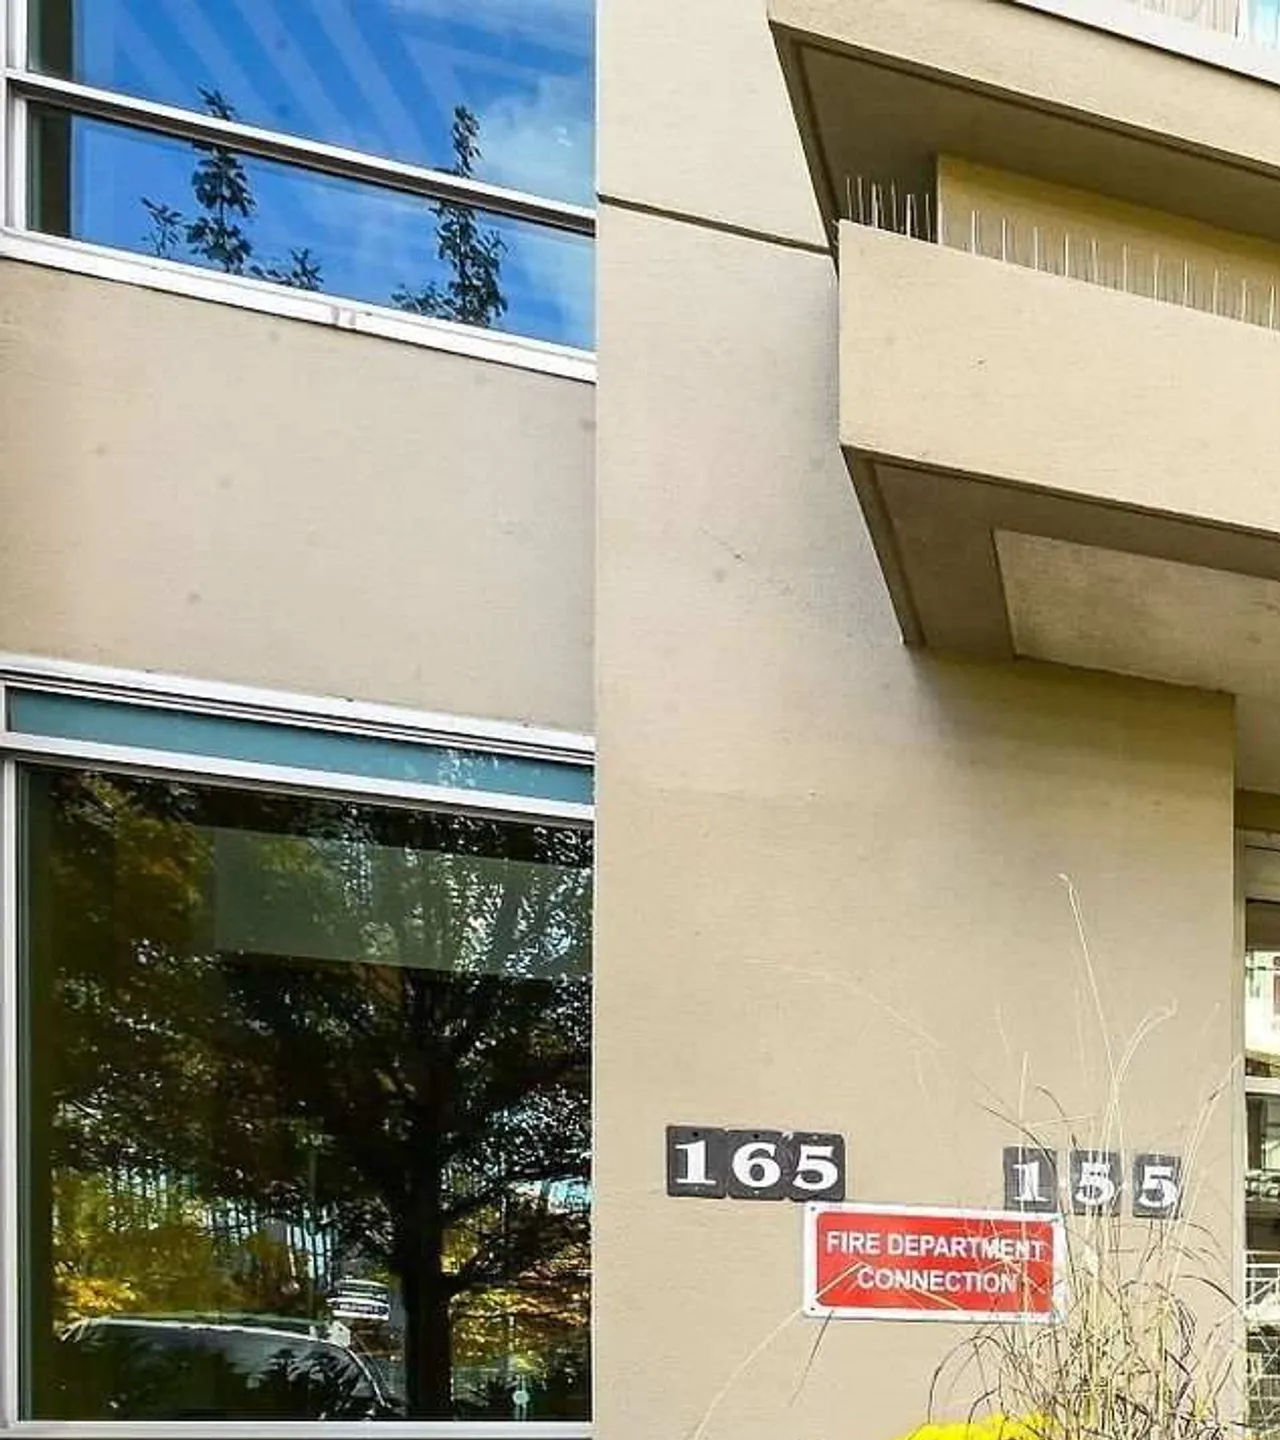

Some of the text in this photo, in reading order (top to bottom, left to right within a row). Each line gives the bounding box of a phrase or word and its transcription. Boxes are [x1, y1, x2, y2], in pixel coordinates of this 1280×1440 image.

[675, 1139, 840, 1191] 165
[1011, 1159, 1179, 1208] 155
[826, 1231, 1045, 1263] FIRE DEPARTMENT
[857, 1266, 1019, 1294] CONNECTION
